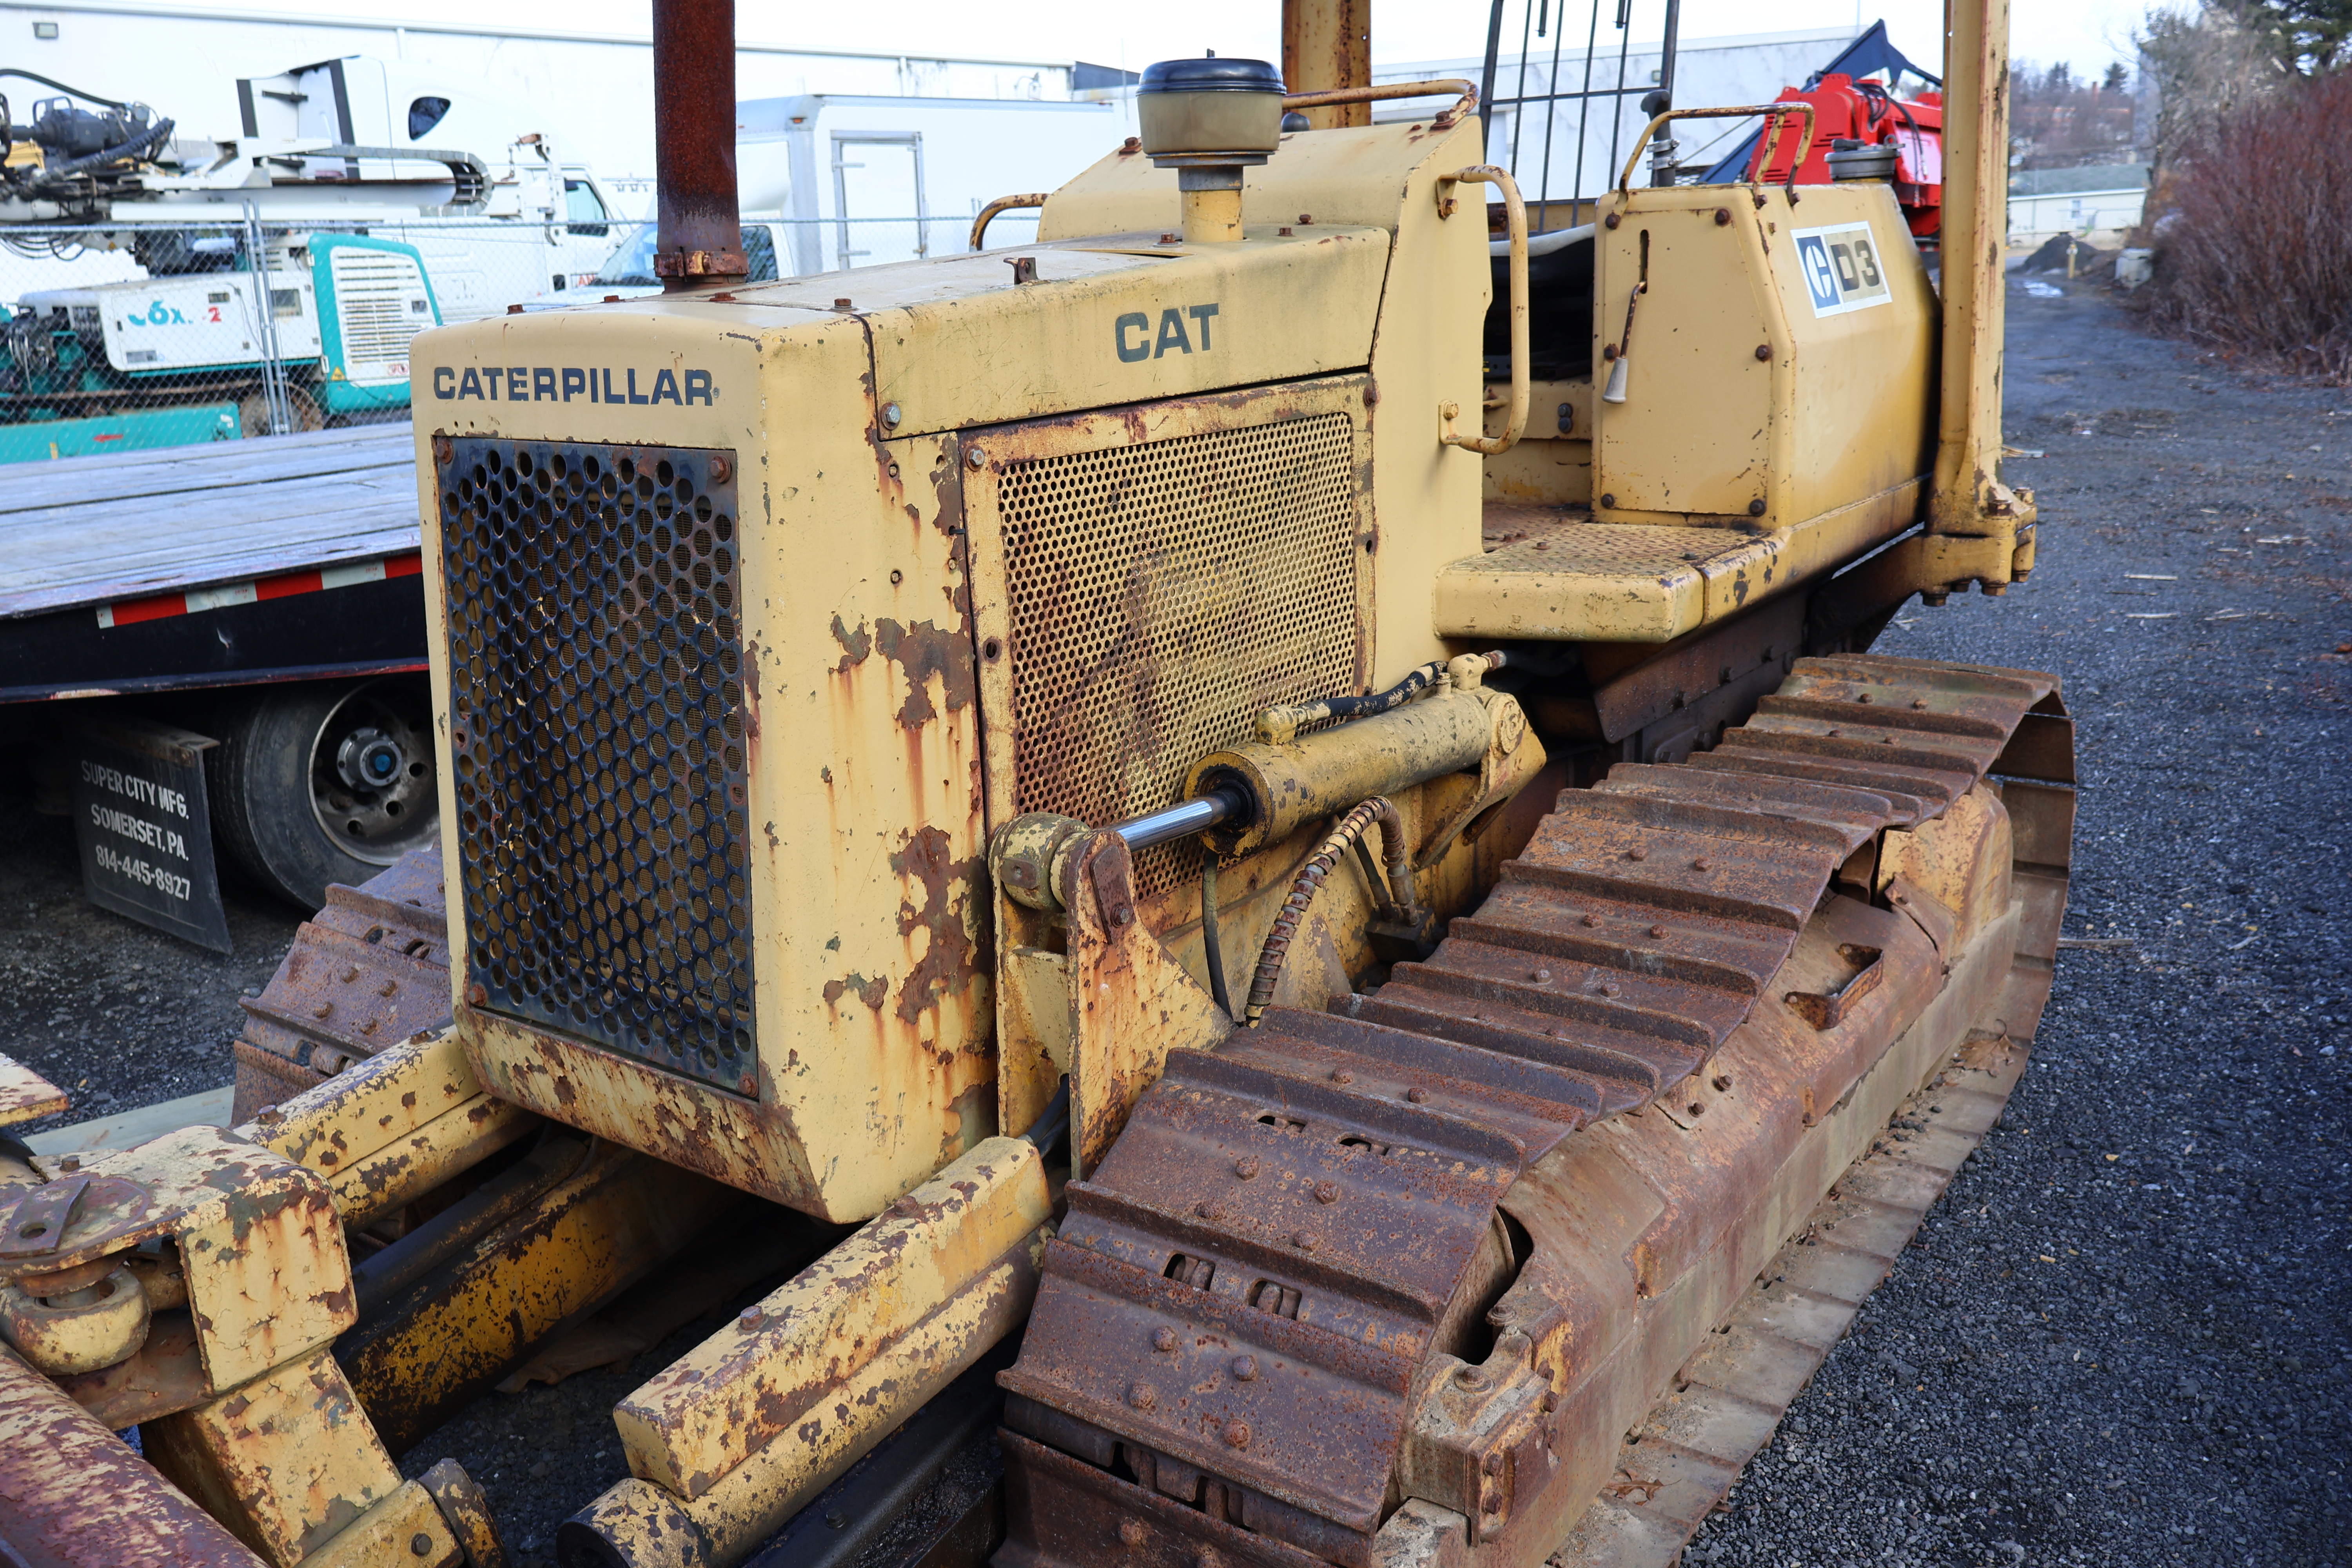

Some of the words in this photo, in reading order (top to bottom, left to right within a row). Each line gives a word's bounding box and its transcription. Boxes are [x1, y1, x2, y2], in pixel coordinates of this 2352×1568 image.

[1830, 240, 1880, 292] D3
[1115, 303, 1219, 363] CAT
[433, 367, 713, 406] CATERPILLAR
[82, 760, 123, 795] SUPER
[125, 775, 156, 806] CITY
[158, 786, 189, 820] MFG.
[91, 804, 166, 853] SOMERSET,
[167, 830, 189, 861] PA.
[96, 844, 191, 901] 814-445-8927
